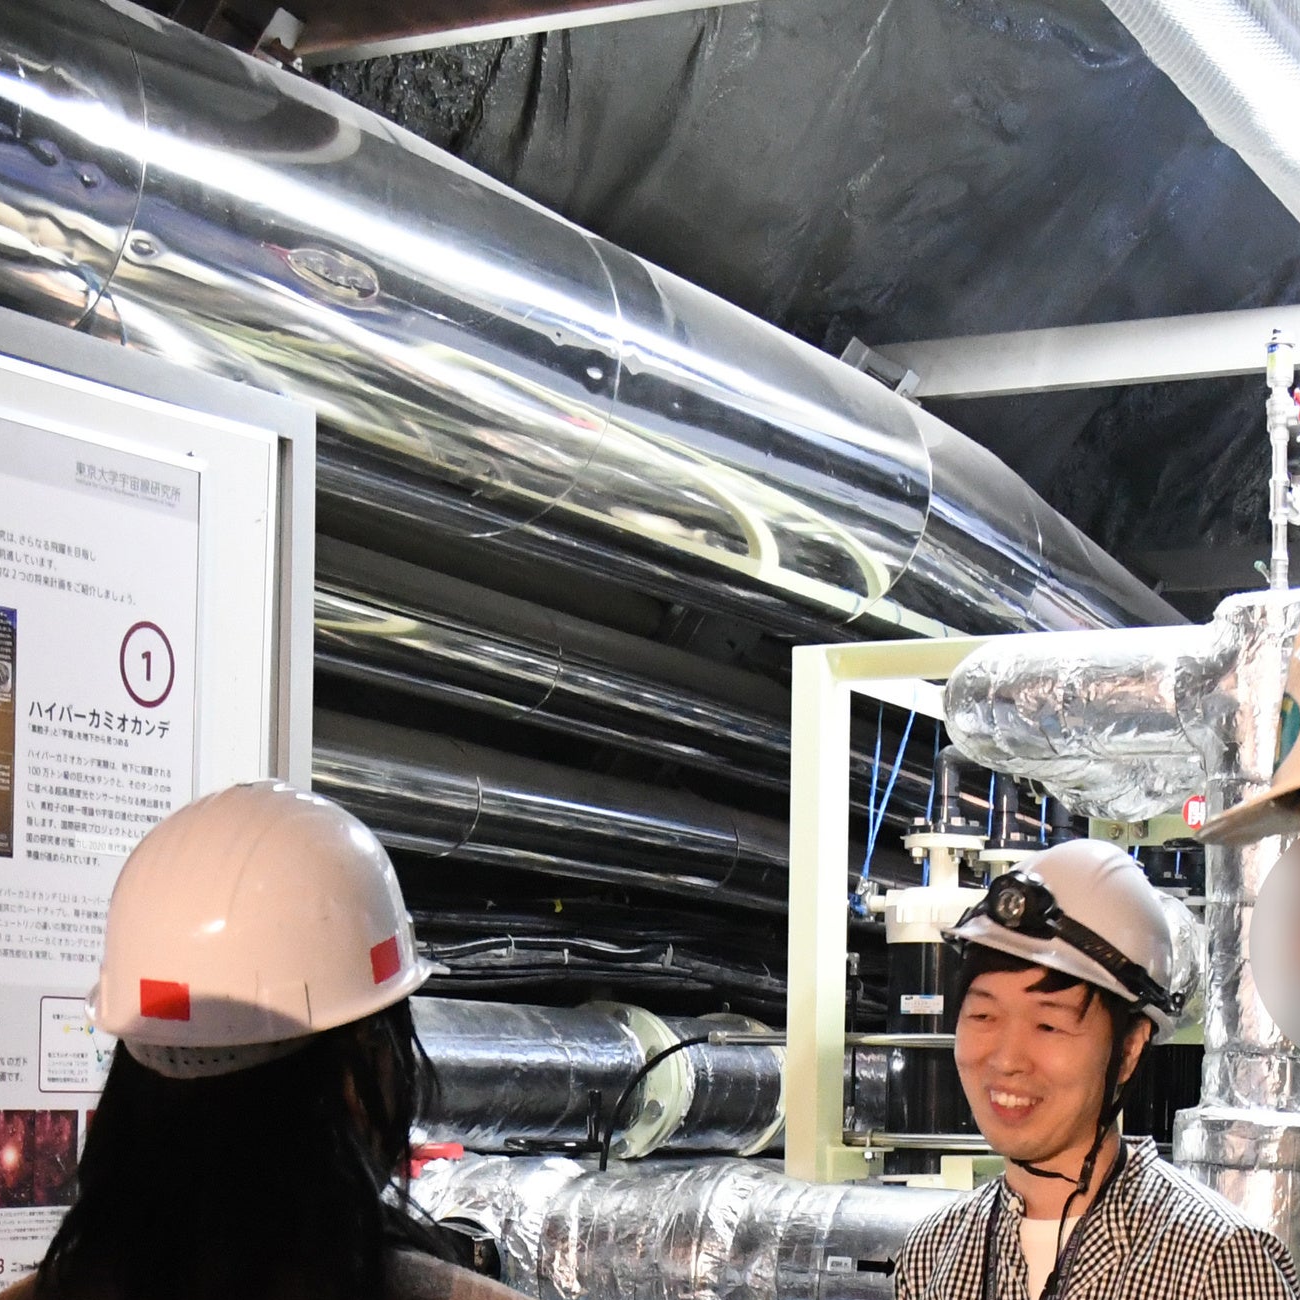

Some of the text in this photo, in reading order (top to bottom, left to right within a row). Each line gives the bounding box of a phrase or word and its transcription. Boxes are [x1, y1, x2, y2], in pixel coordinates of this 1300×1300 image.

[76, 461, 180, 502] 東京大学宇宙線研究所
[142, 650, 153, 683] 1
[29, 702, 170, 739] ハイパーカミオカンデ
